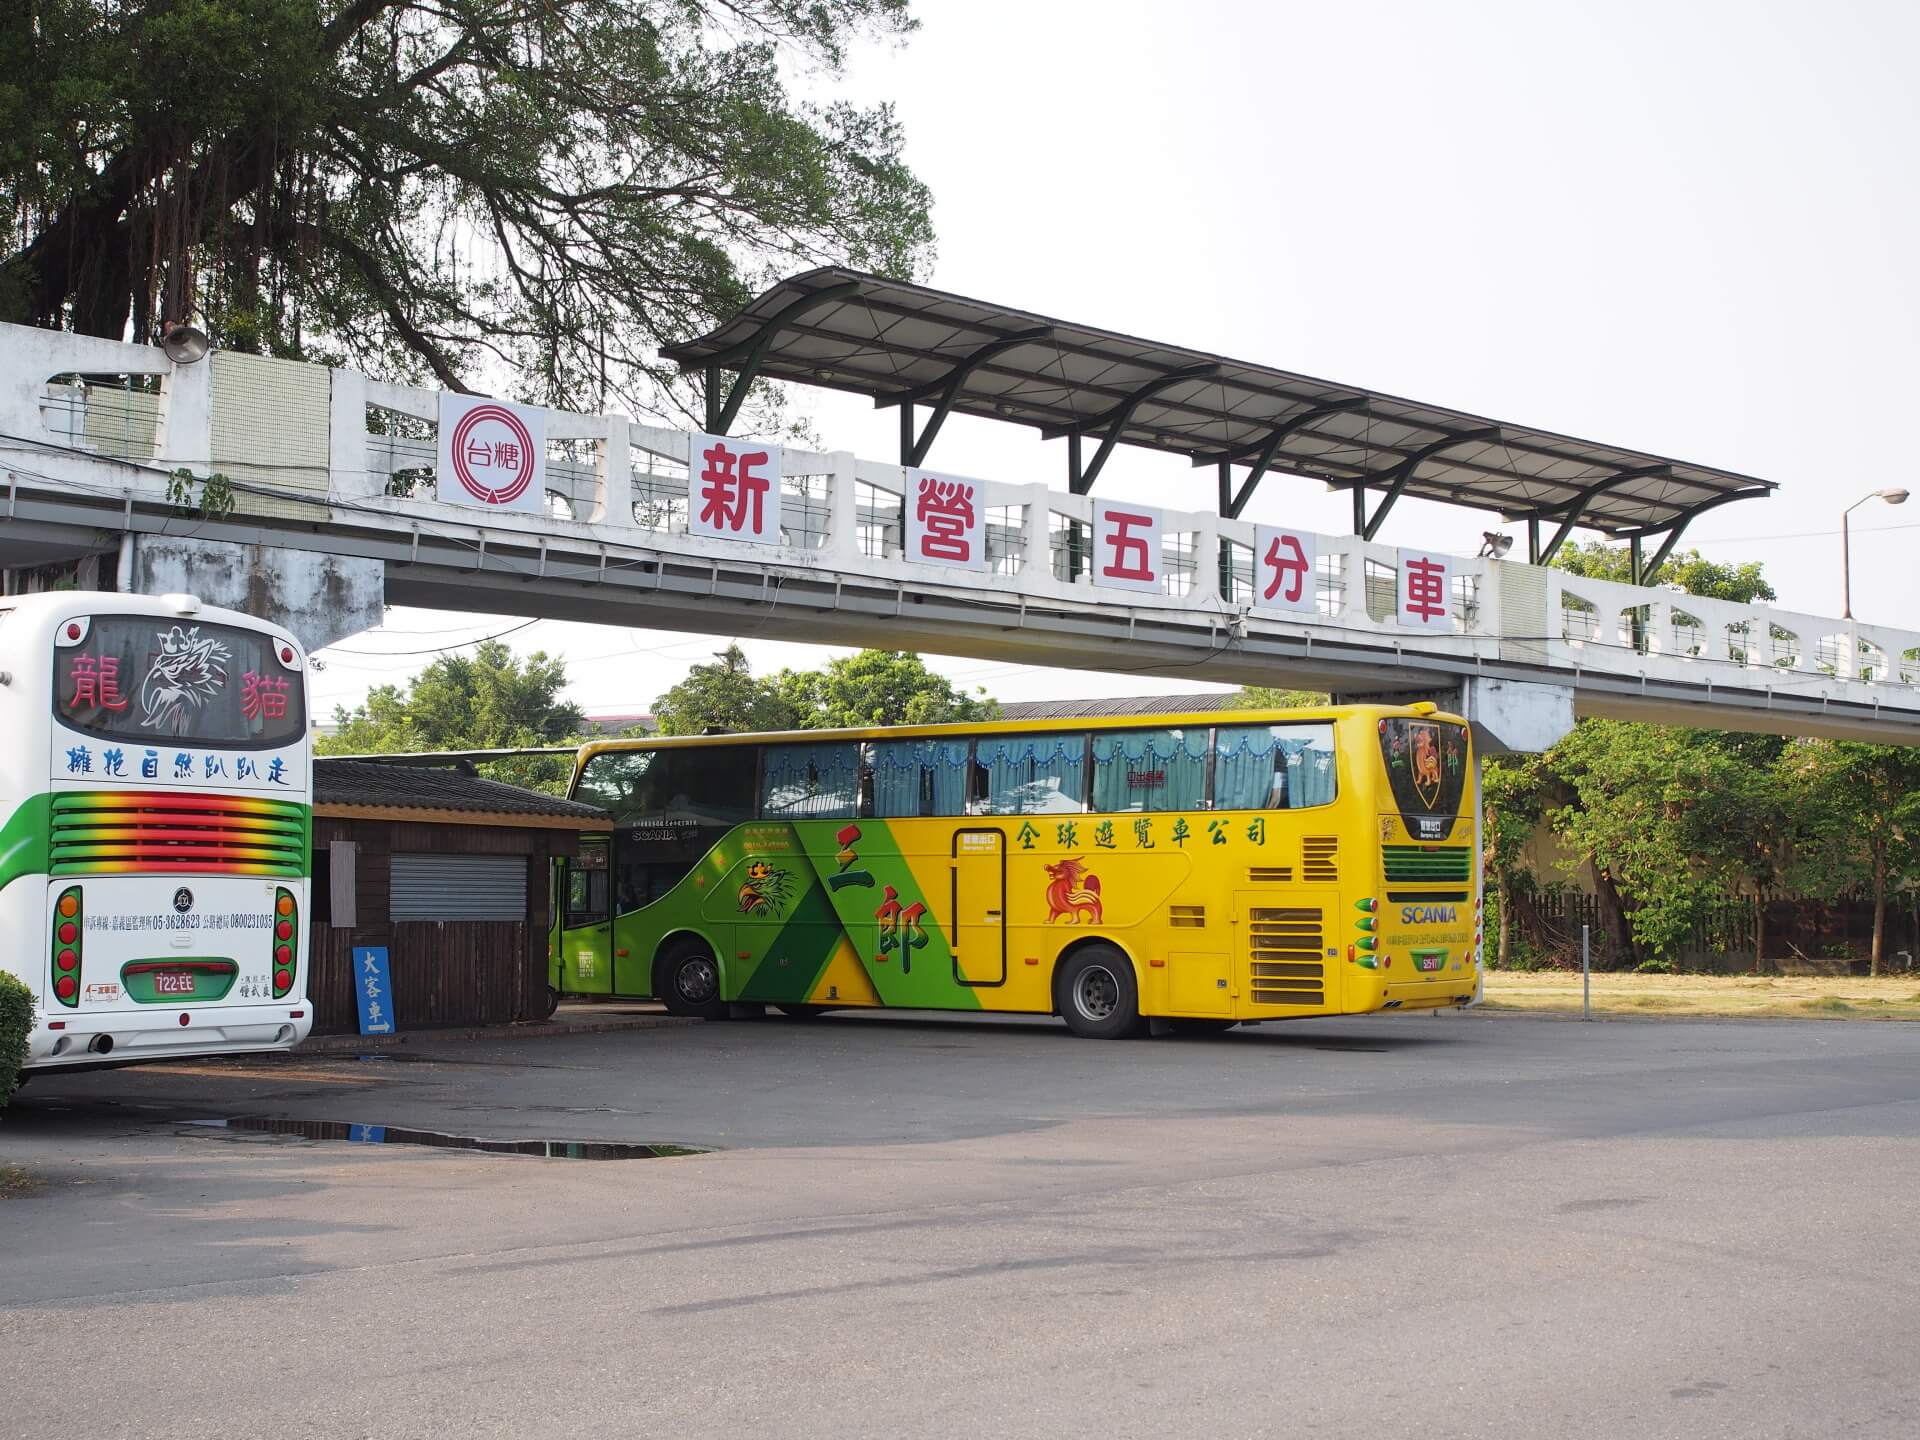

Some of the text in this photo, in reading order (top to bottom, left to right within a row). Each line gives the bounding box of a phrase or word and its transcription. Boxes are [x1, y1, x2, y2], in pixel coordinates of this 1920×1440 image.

[466, 437, 519, 471] 台糖
[66, 745, 291, 786] 擁抱自然趴趴走
[632, 830, 677, 841] SCANIA
[1016, 817, 1266, 849] 全球遊覽車公司
[1401, 906, 1457, 925] SCANIA
[157, 975, 193, 991] 722-EE
[364, 951, 383, 1024] 大客車
